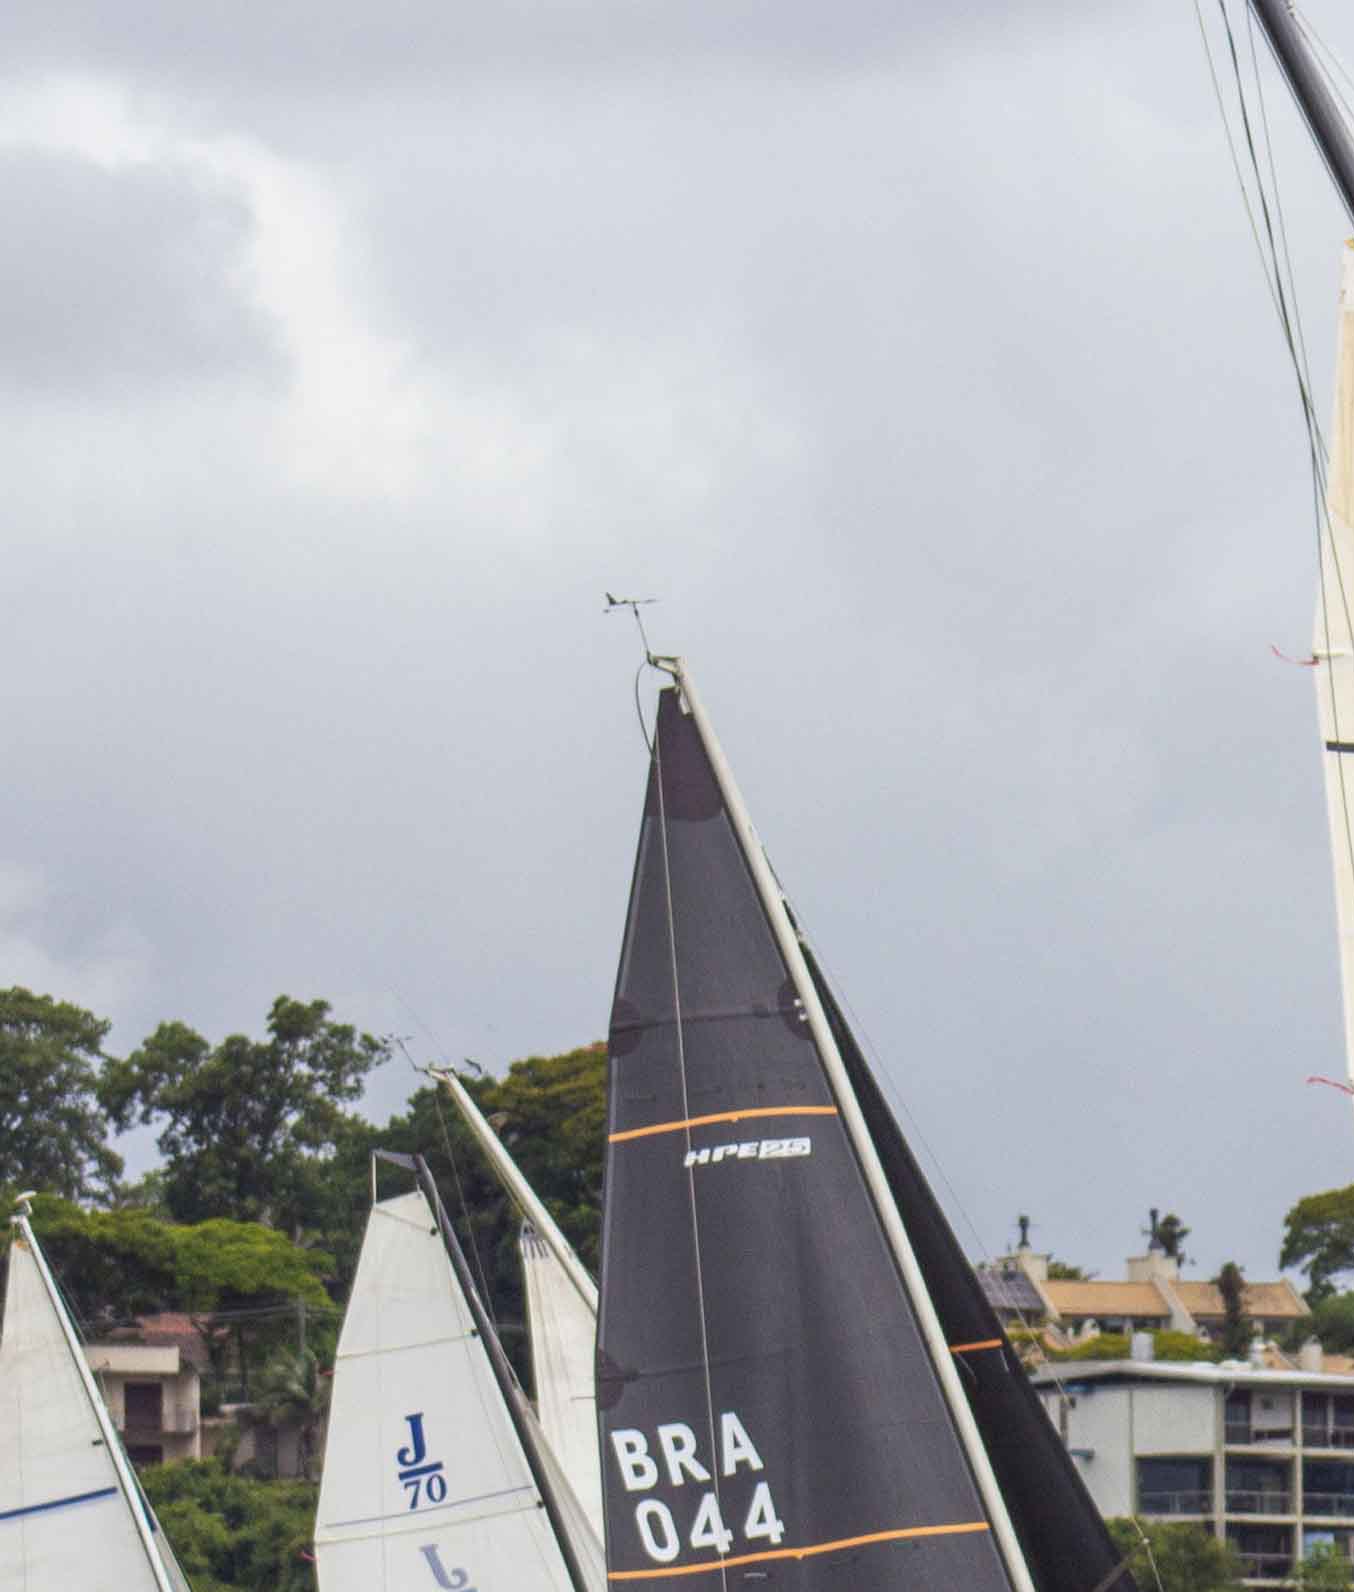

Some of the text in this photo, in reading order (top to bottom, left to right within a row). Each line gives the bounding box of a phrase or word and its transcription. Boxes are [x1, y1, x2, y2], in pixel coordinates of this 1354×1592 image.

[397, 1413, 424, 1467] J
[611, 1411, 764, 1492] BRA
[403, 1474, 447, 1510] 70
[635, 1481, 785, 1562] 044
